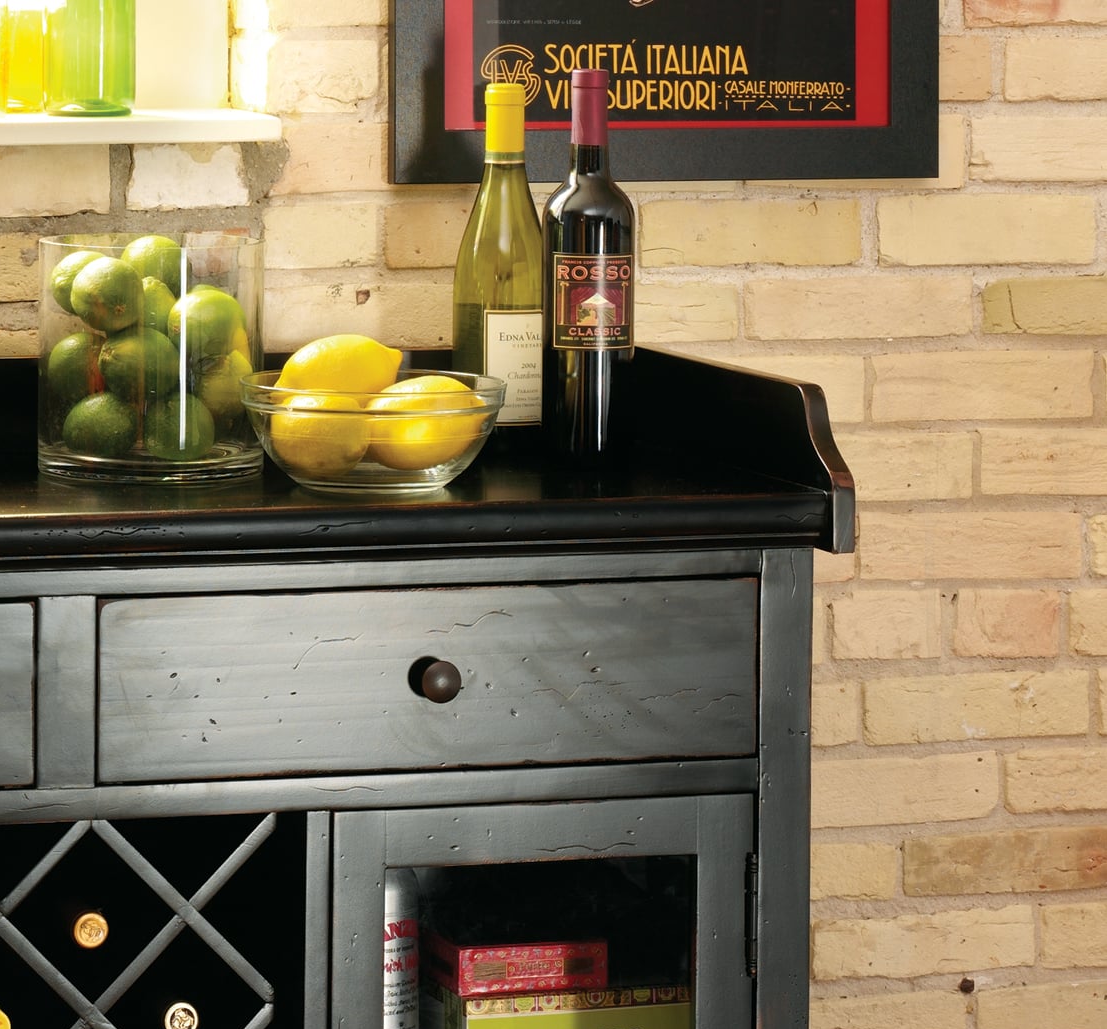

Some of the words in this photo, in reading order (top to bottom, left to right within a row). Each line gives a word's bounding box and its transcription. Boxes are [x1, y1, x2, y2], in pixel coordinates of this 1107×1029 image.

[646, 44, 749, 75] ITALIANA
[724, 80, 766, 95] CASALE
[769, 81, 845, 96] MONFERRATO
[724, 99, 844, 112] ITALIA
[557, 265, 631, 281] ROSSO
[499, 332, 524, 342] EDNA
[526, 331, 542, 342] VAL
[568, 327, 621, 336] CLASSIC
